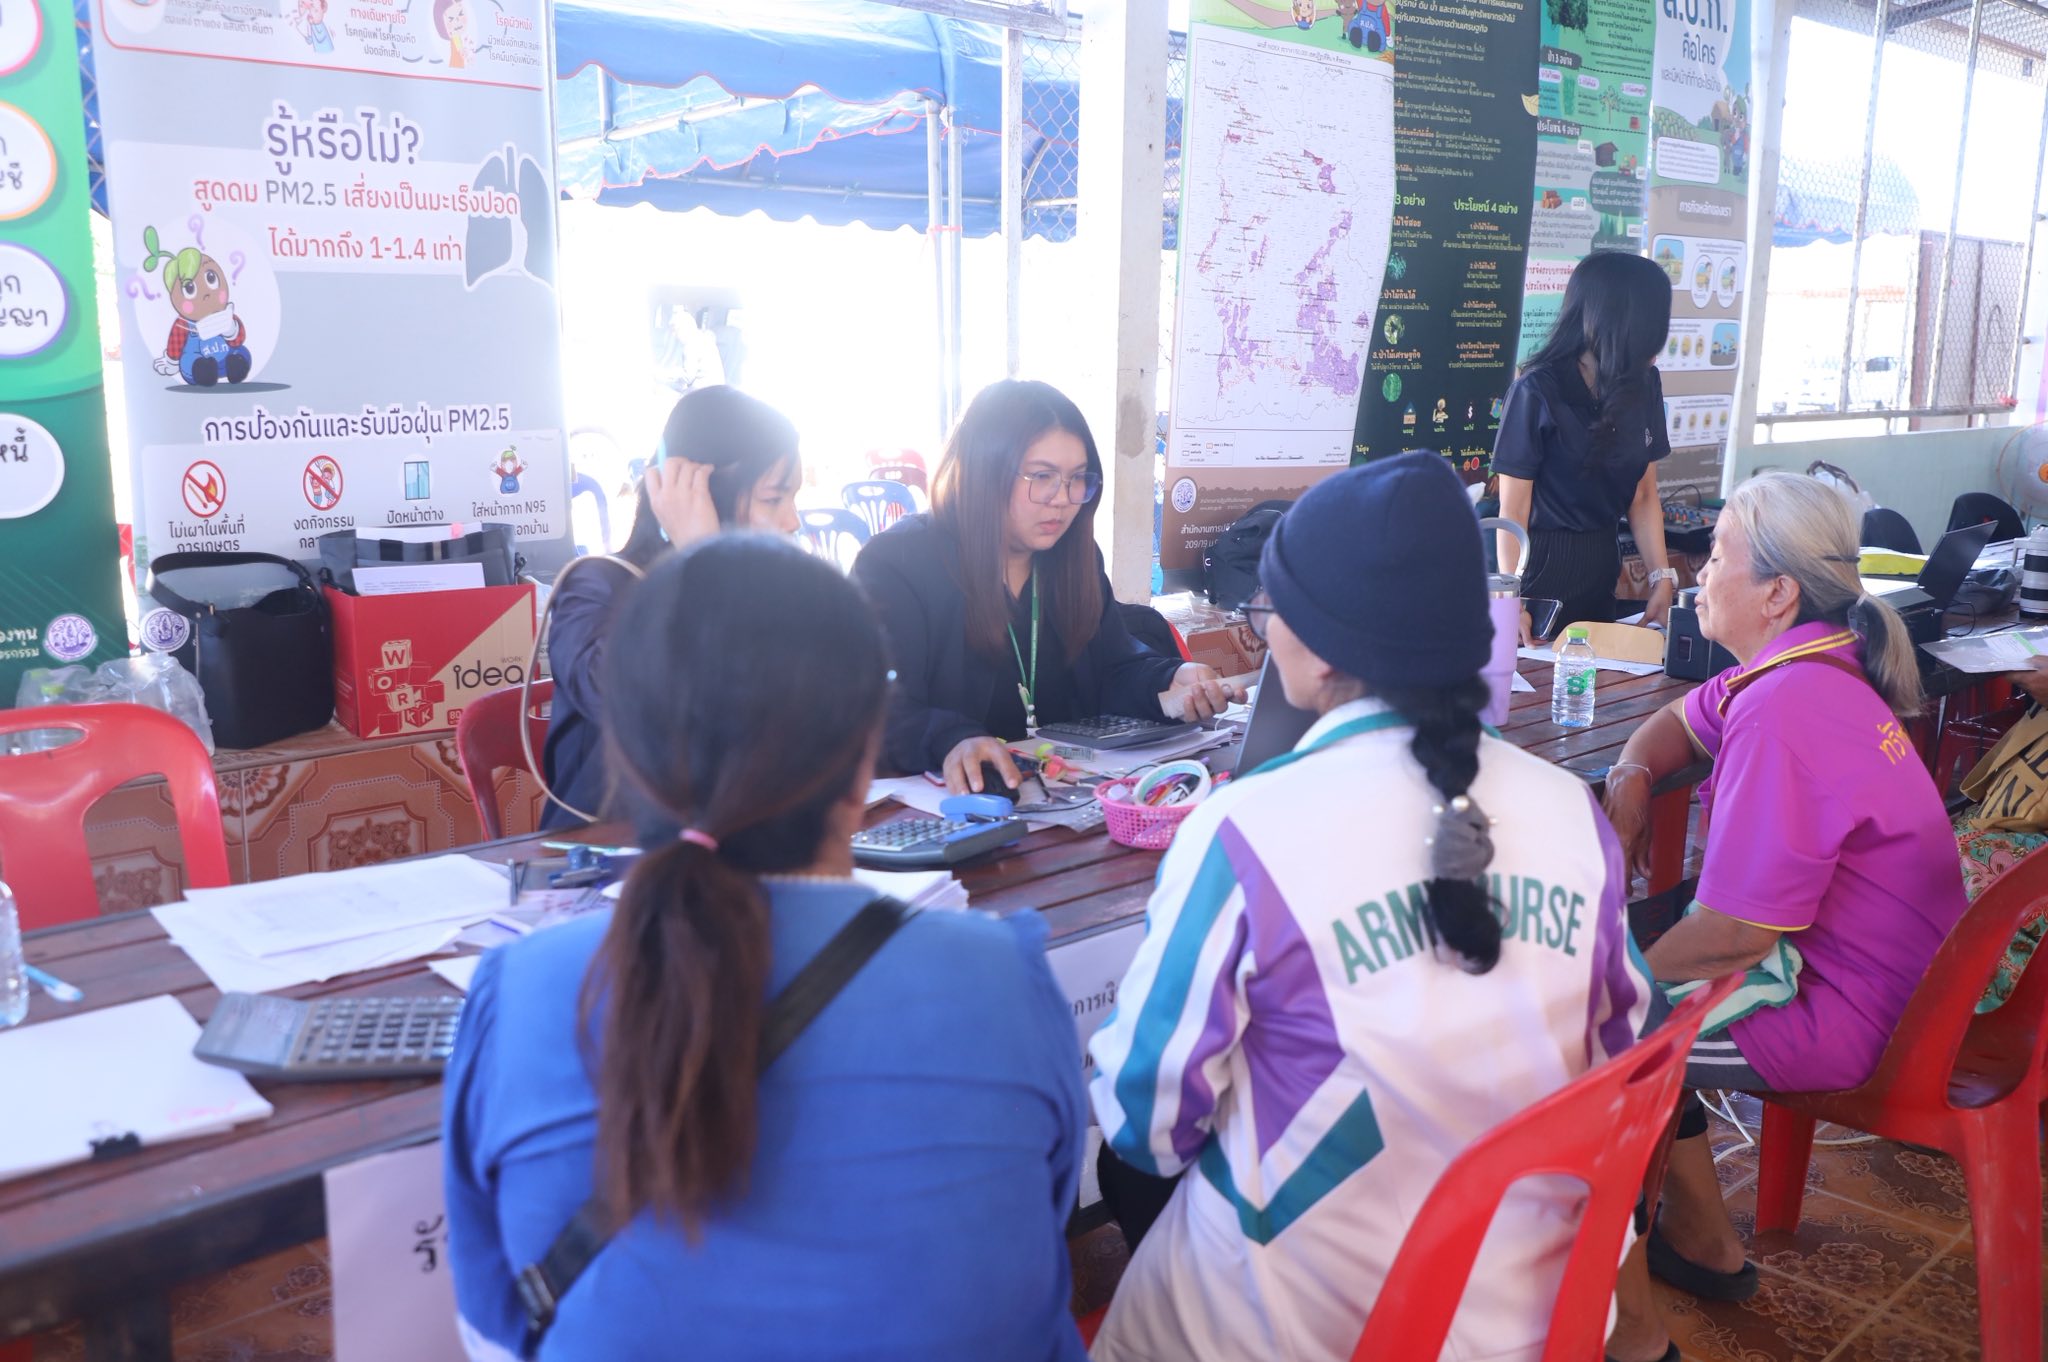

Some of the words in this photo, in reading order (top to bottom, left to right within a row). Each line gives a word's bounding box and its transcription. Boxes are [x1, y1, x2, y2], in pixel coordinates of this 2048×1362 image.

[1682, 32, 1716, 66] คือใคร
[267, 104, 420, 176] รู้หรือไม่?
[194, 180, 258, 212] สูดดม
[265, 180, 337, 206] PM2.5
[344, 173, 518, 215] เสี่ยงเป็นมะเร็งปอด
[1403, 193, 1426, 207] อย่าง
[1453, 197, 1490, 212] ประโยชน์
[1491, 203, 1497, 214] 4
[1498, 202, 1518, 215] อย่าง
[268, 227, 364, 259] ได้มากถึง
[370, 236, 427, 260] 1-1.4
[432, 235, 463, 262] เท่า
[204, 405, 443, 444] การป้องกันและรับมือฝุ่น
[448, 407, 510, 432] PM2.5
[294, 514, 355, 531] งดกิจกรรม
[387, 505, 444, 525] ปิดหน้าต่าง
[472, 500, 523, 518] ใส่หน้ากาก
[525, 500, 546, 514] N95
[168, 514, 246, 538] ไม่เผาในพื้นที่
[453, 659, 525, 690] idea
[1331, 879, 1437, 986] ARM
[1476, 872, 1586, 957] URSE
